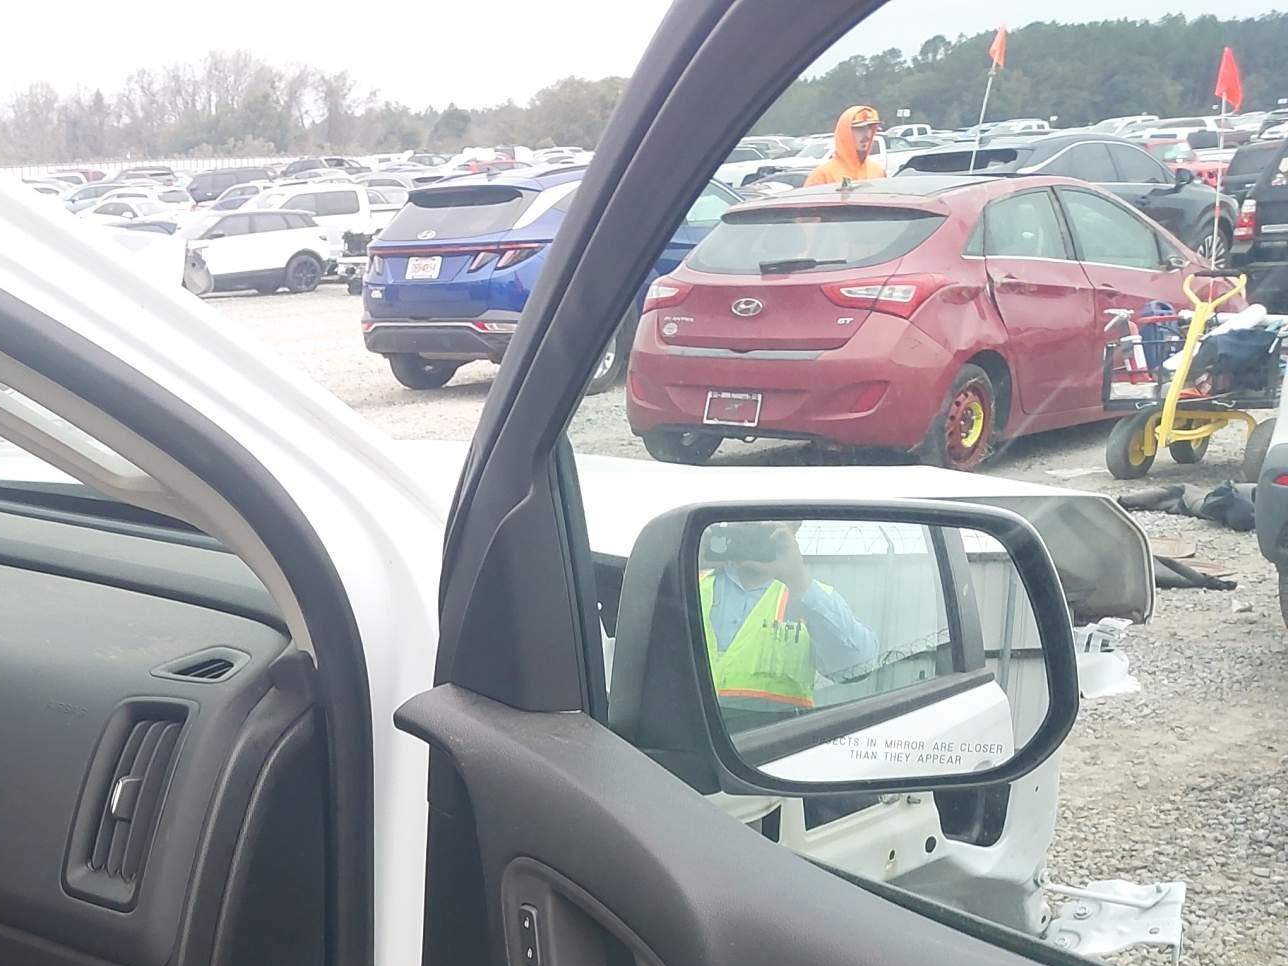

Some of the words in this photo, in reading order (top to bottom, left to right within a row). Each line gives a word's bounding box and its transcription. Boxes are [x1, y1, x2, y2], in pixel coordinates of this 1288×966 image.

[837, 317, 855, 325] GT
[813, 735, 859, 747] JECTS
[866, 738, 877, 748] IN
[884, 739, 925, 750] MIRROR
[932, 741, 954, 752] ARE
[959, 742, 1003, 754] CLOSER
[850, 749, 878, 760] THAN
[884, 751, 911, 762] THEY
[916, 753, 962, 765] APPEAR
